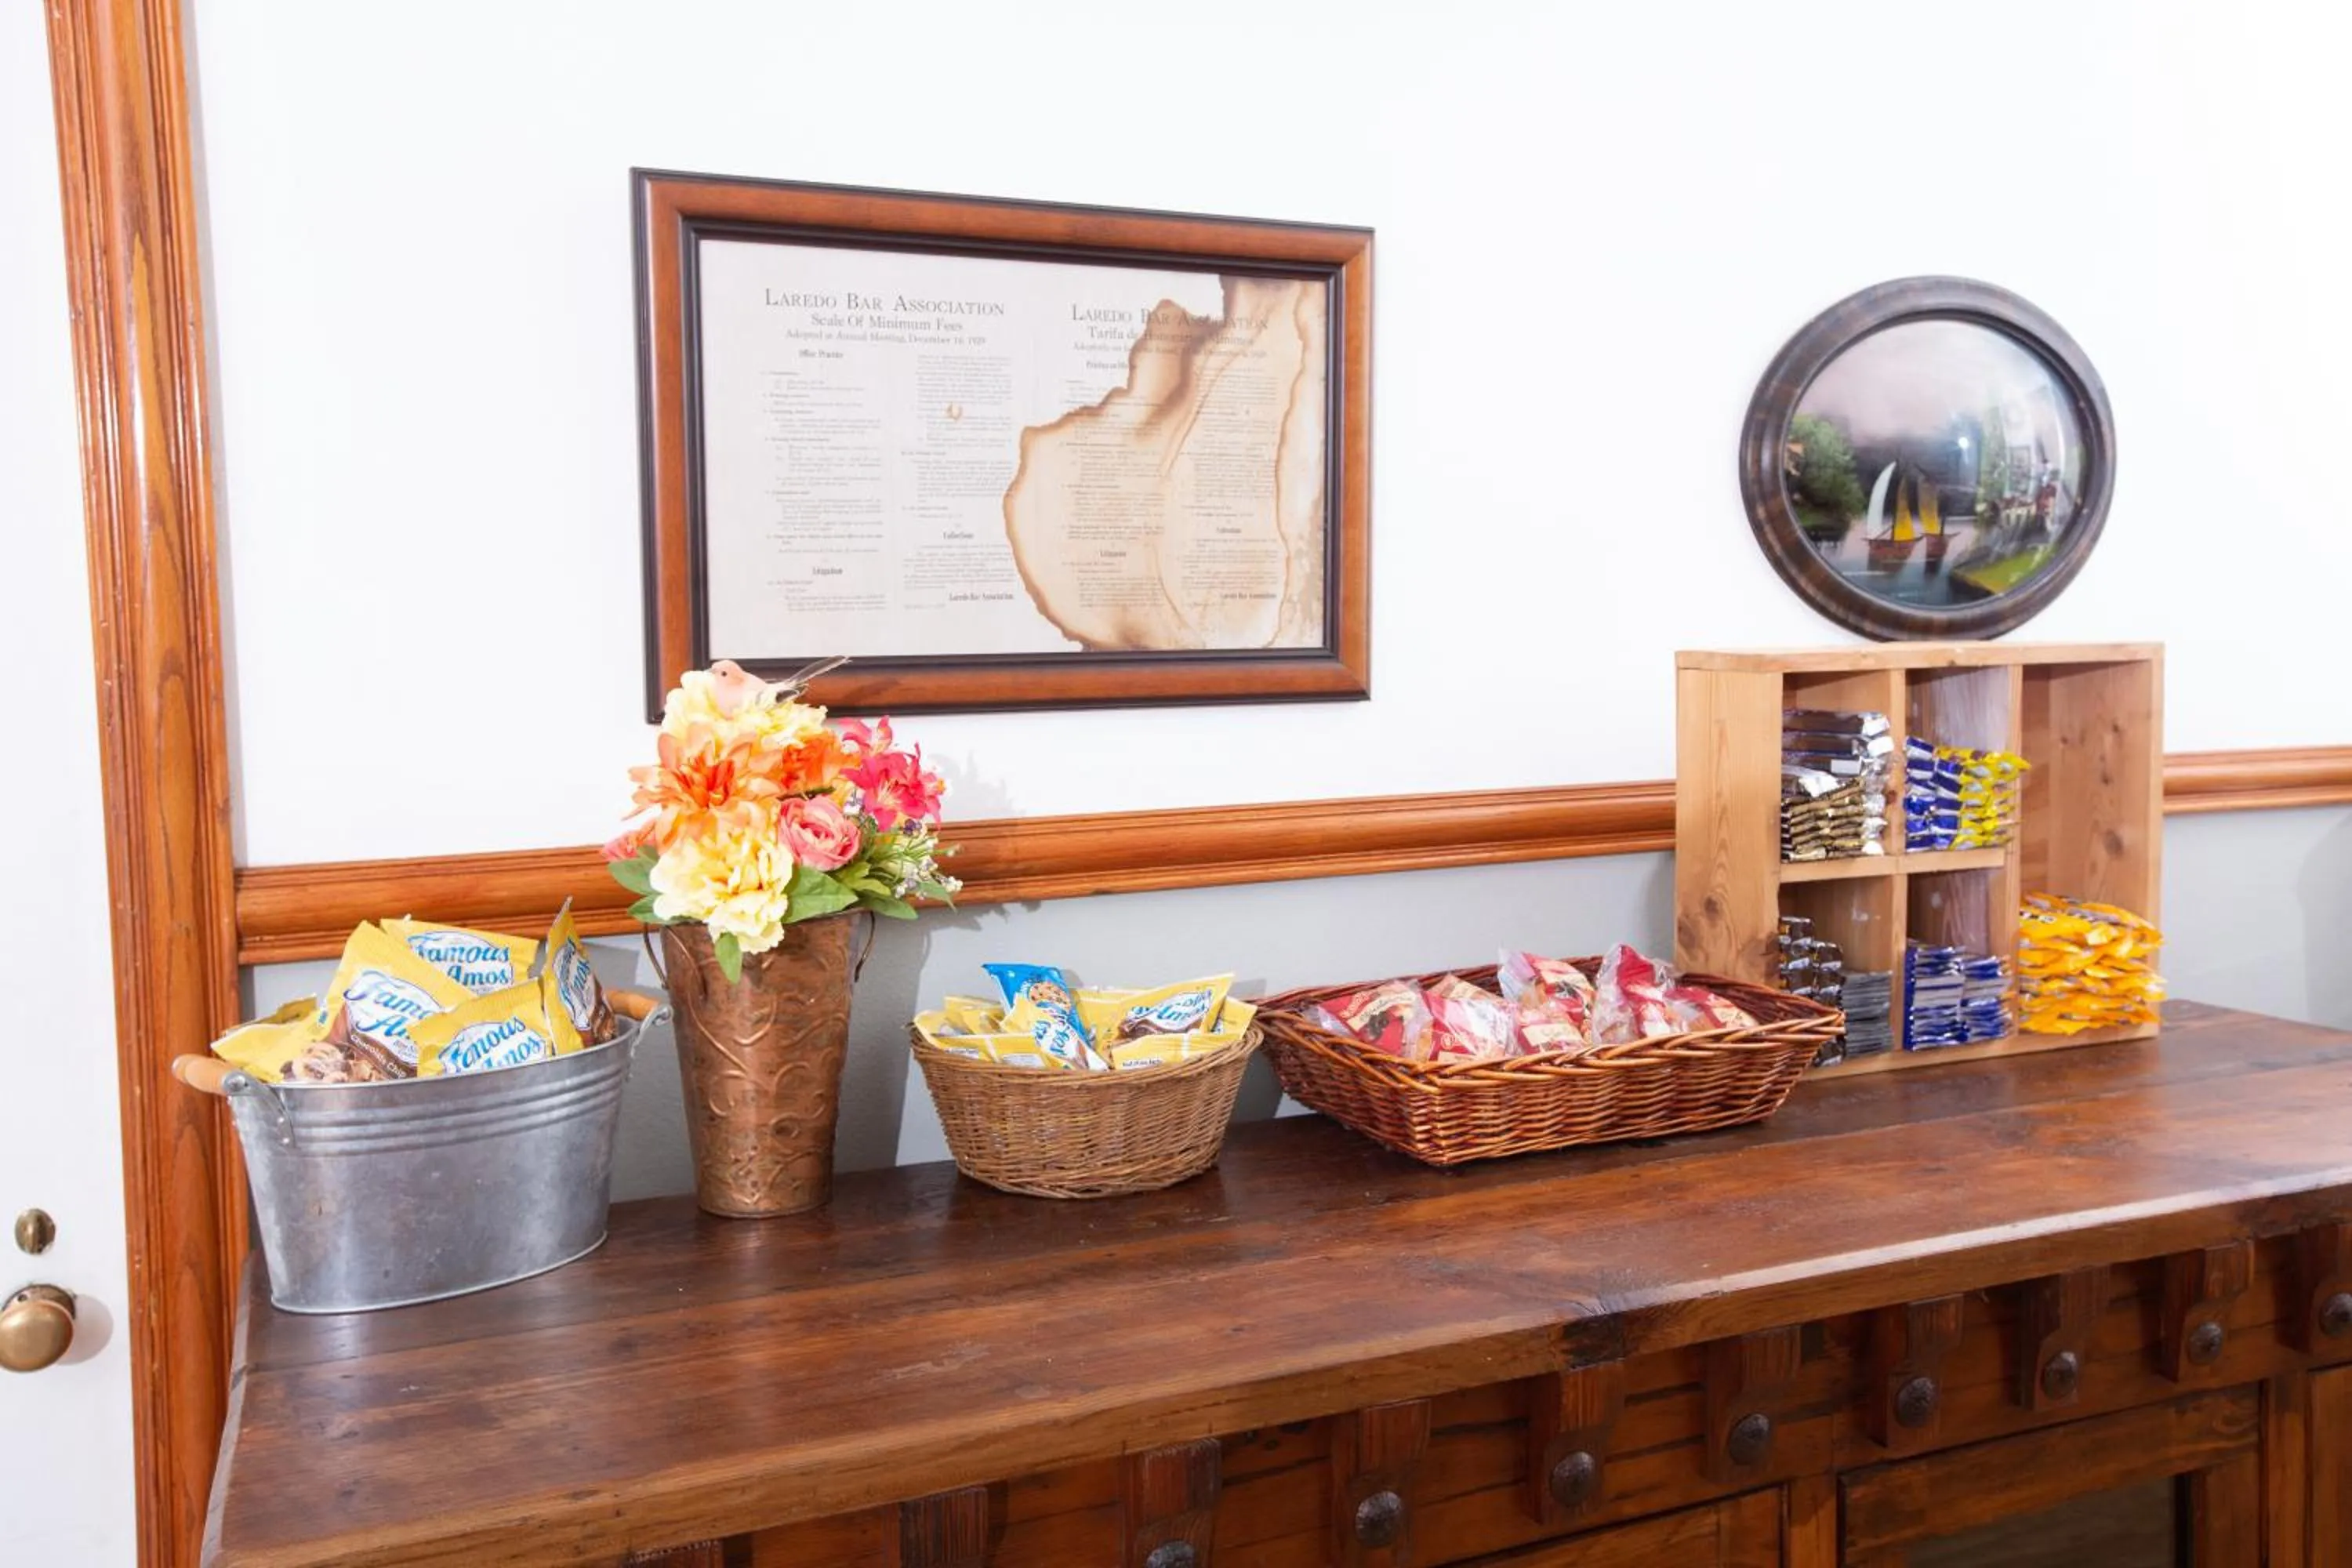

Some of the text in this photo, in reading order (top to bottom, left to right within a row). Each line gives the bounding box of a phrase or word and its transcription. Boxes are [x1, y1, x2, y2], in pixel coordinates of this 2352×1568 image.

[765, 288, 1005, 317] LAREDO BAR ASSOCIATION
[811, 314, 844, 327] Scale
[869, 317, 931, 331] Minimum
[935, 319, 964, 332] Fees
[1073, 304, 1133, 323] LAREDO
[1141, 308, 1171, 326] BAR
[1088, 326, 1125, 340] Tarifa
[407, 935, 510, 964] Famous
[447, 965, 510, 986] Amos
